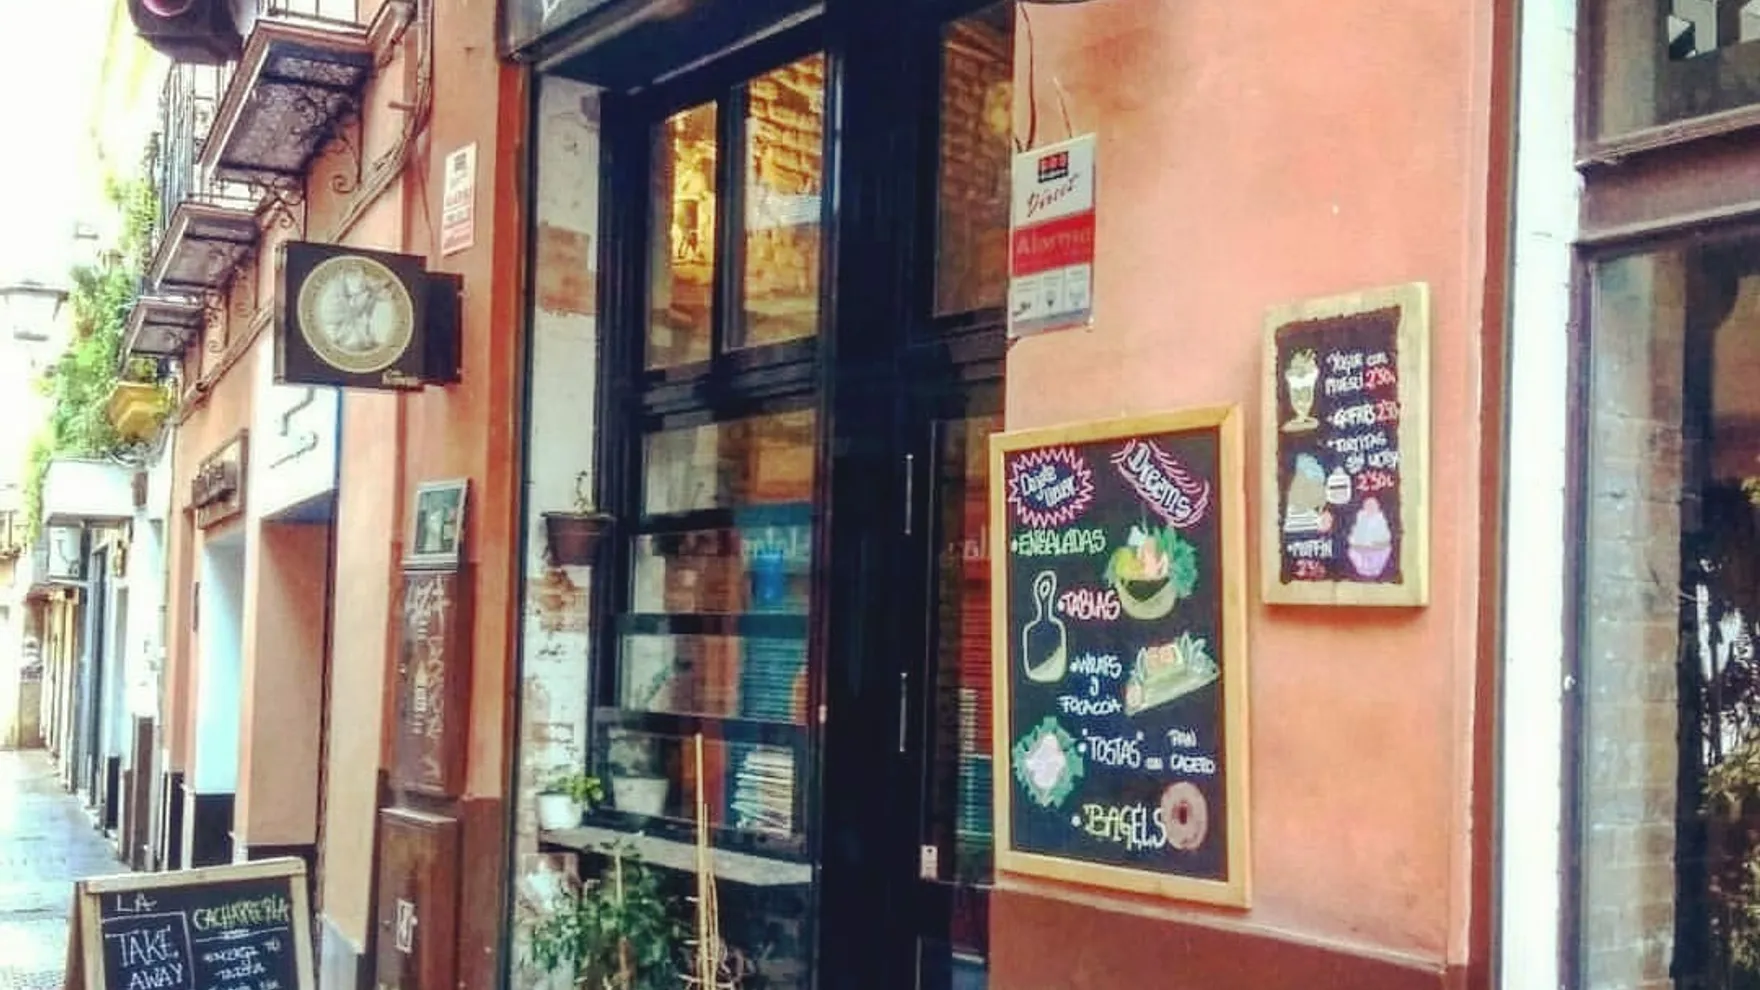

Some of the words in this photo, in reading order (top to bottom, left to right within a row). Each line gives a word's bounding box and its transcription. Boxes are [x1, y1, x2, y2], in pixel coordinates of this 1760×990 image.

[1017, 528, 1106, 556] ENSALADAS
[1061, 588, 1121, 621] TABLAS
[116, 893, 158, 913] LA
[105, 925, 179, 967] TAKE
[130, 962, 183, 990] AWAY
